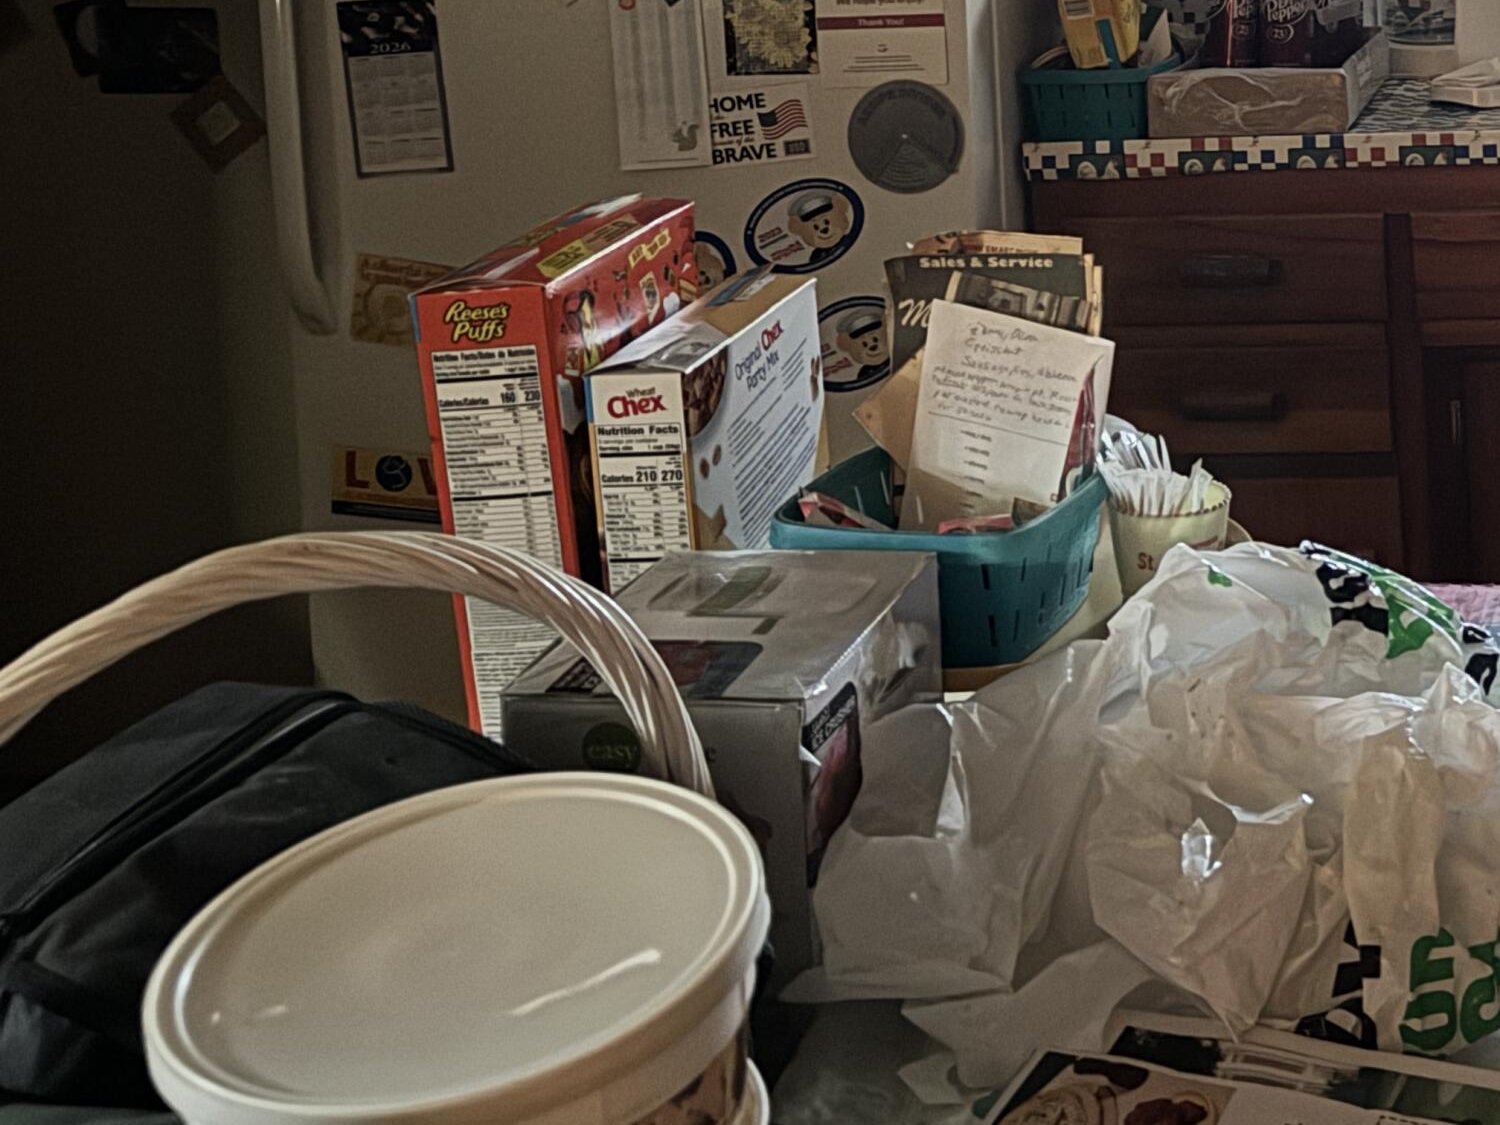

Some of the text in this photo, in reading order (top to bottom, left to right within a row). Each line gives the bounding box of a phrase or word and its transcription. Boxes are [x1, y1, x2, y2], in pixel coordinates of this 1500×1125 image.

[858, 17, 884, 26] Thank
[709, 93, 767, 113] HOME
[710, 119, 755, 140] FREE
[712, 143, 777, 165] BRAVE
[919, 256, 1054, 269] Sales & Service
[445, 300, 510, 323] Reese's
[452, 321, 505, 343] Puffs
[734, 319, 785, 382] Original Chex
[745, 347, 781, 392] Party Mix
[500, 391, 516, 404] 160
[626, 387, 656, 399] Wheat
[607, 394, 668, 419] Chex
[598, 425, 679, 436] Nutrition Facts
[601, 469, 683, 484] Calories 210 270
[587, 743, 638, 765] easy
